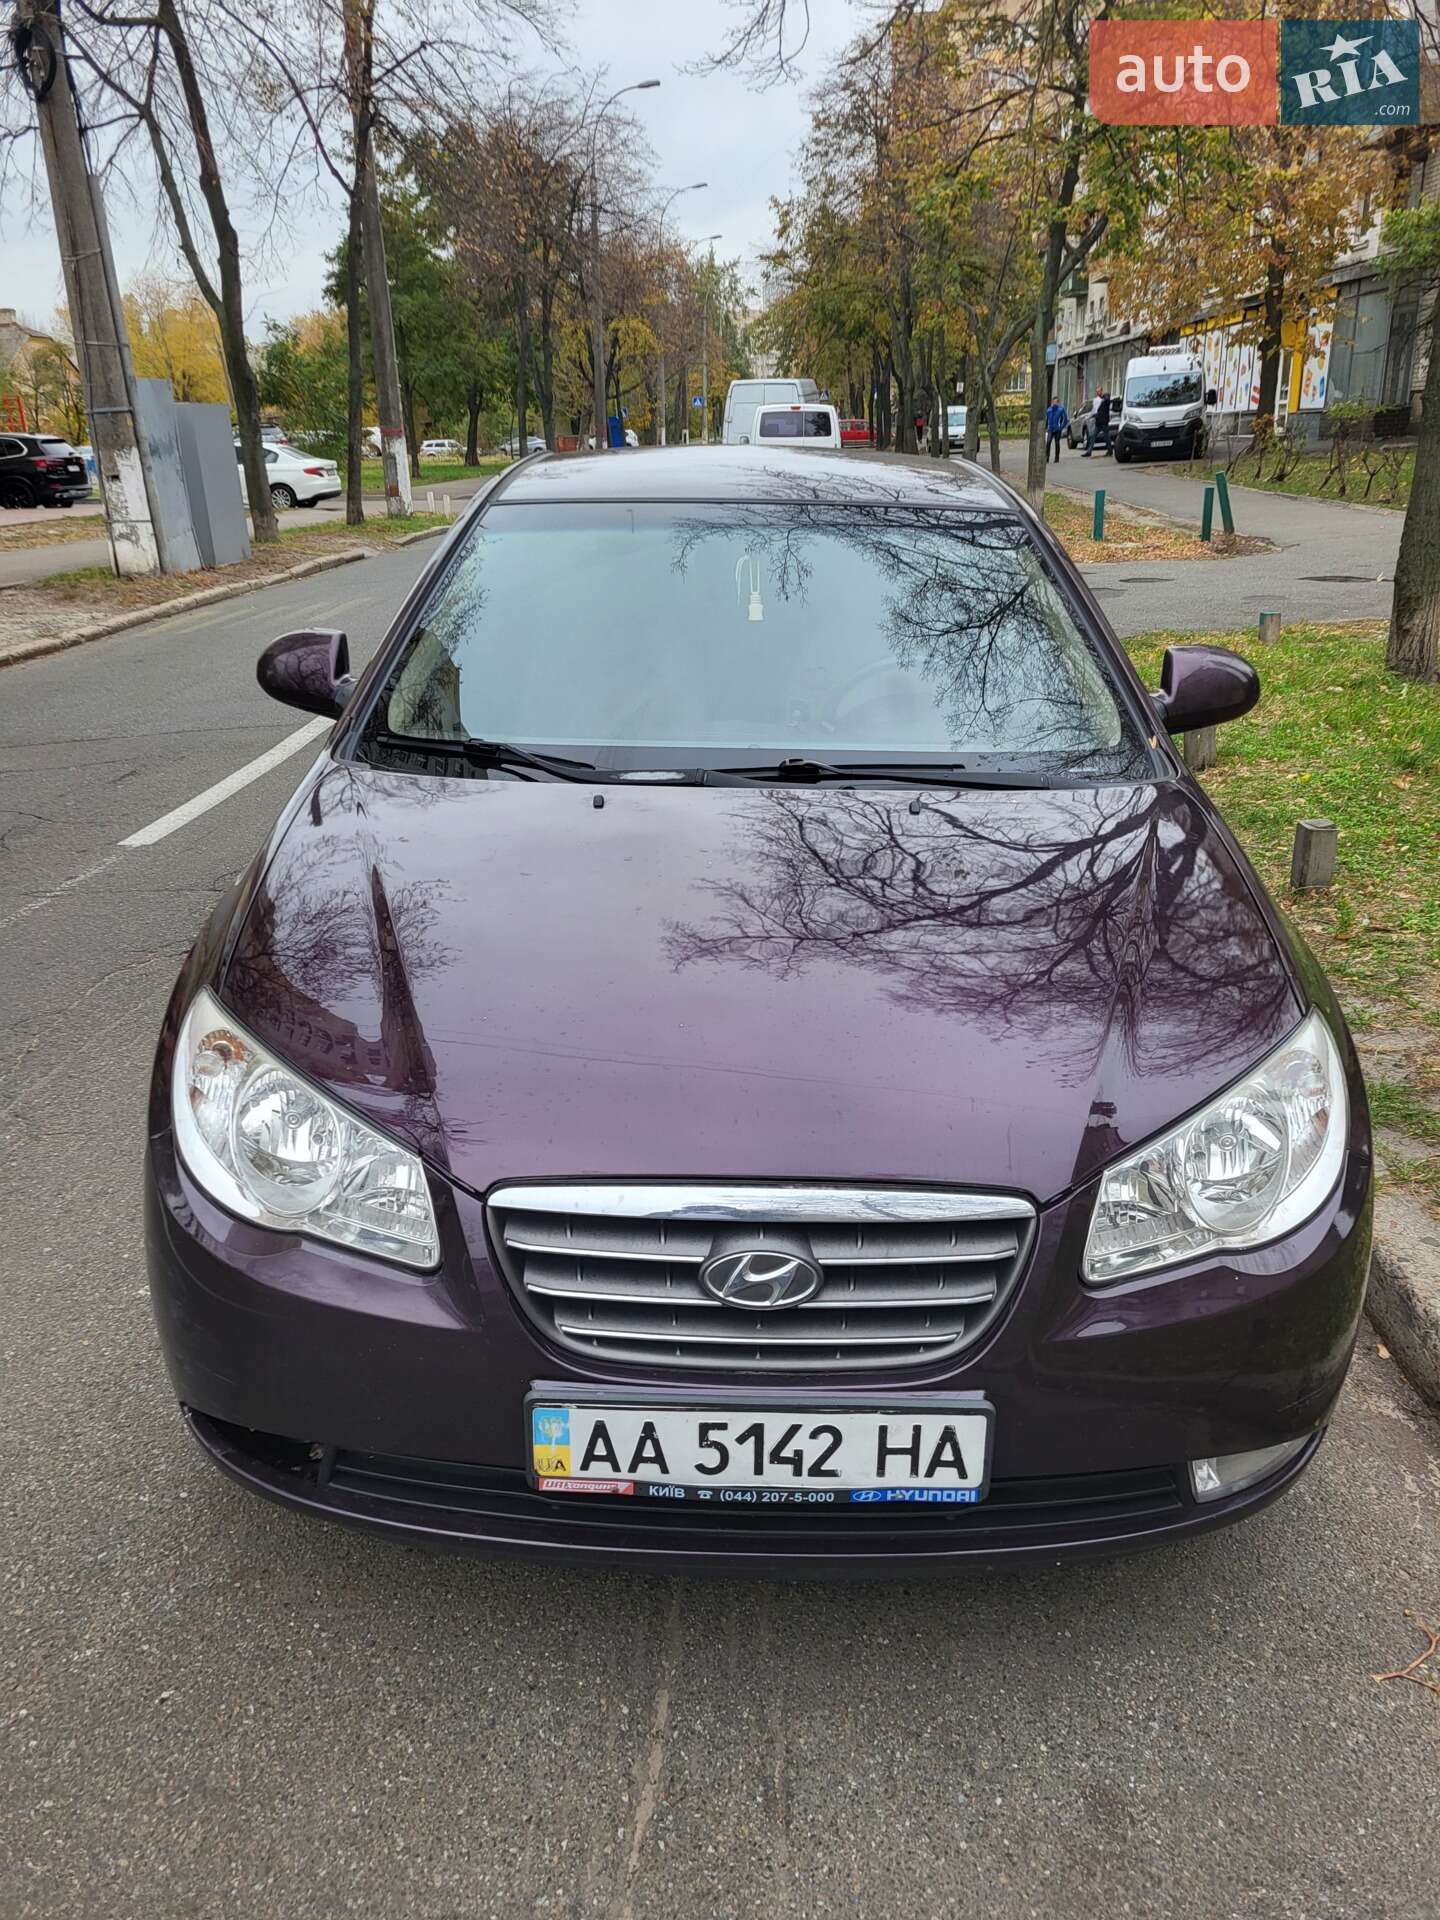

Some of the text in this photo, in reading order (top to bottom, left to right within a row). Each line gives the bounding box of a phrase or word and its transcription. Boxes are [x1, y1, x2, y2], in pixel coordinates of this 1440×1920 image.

[580, 1420, 969, 1480] AA 5142 HA
[536, 1456, 566, 1472] UA
[649, 1485, 835, 1503] КИЇВ (044) 207-5-000
[886, 1490, 976, 1502] HYUNDAI
